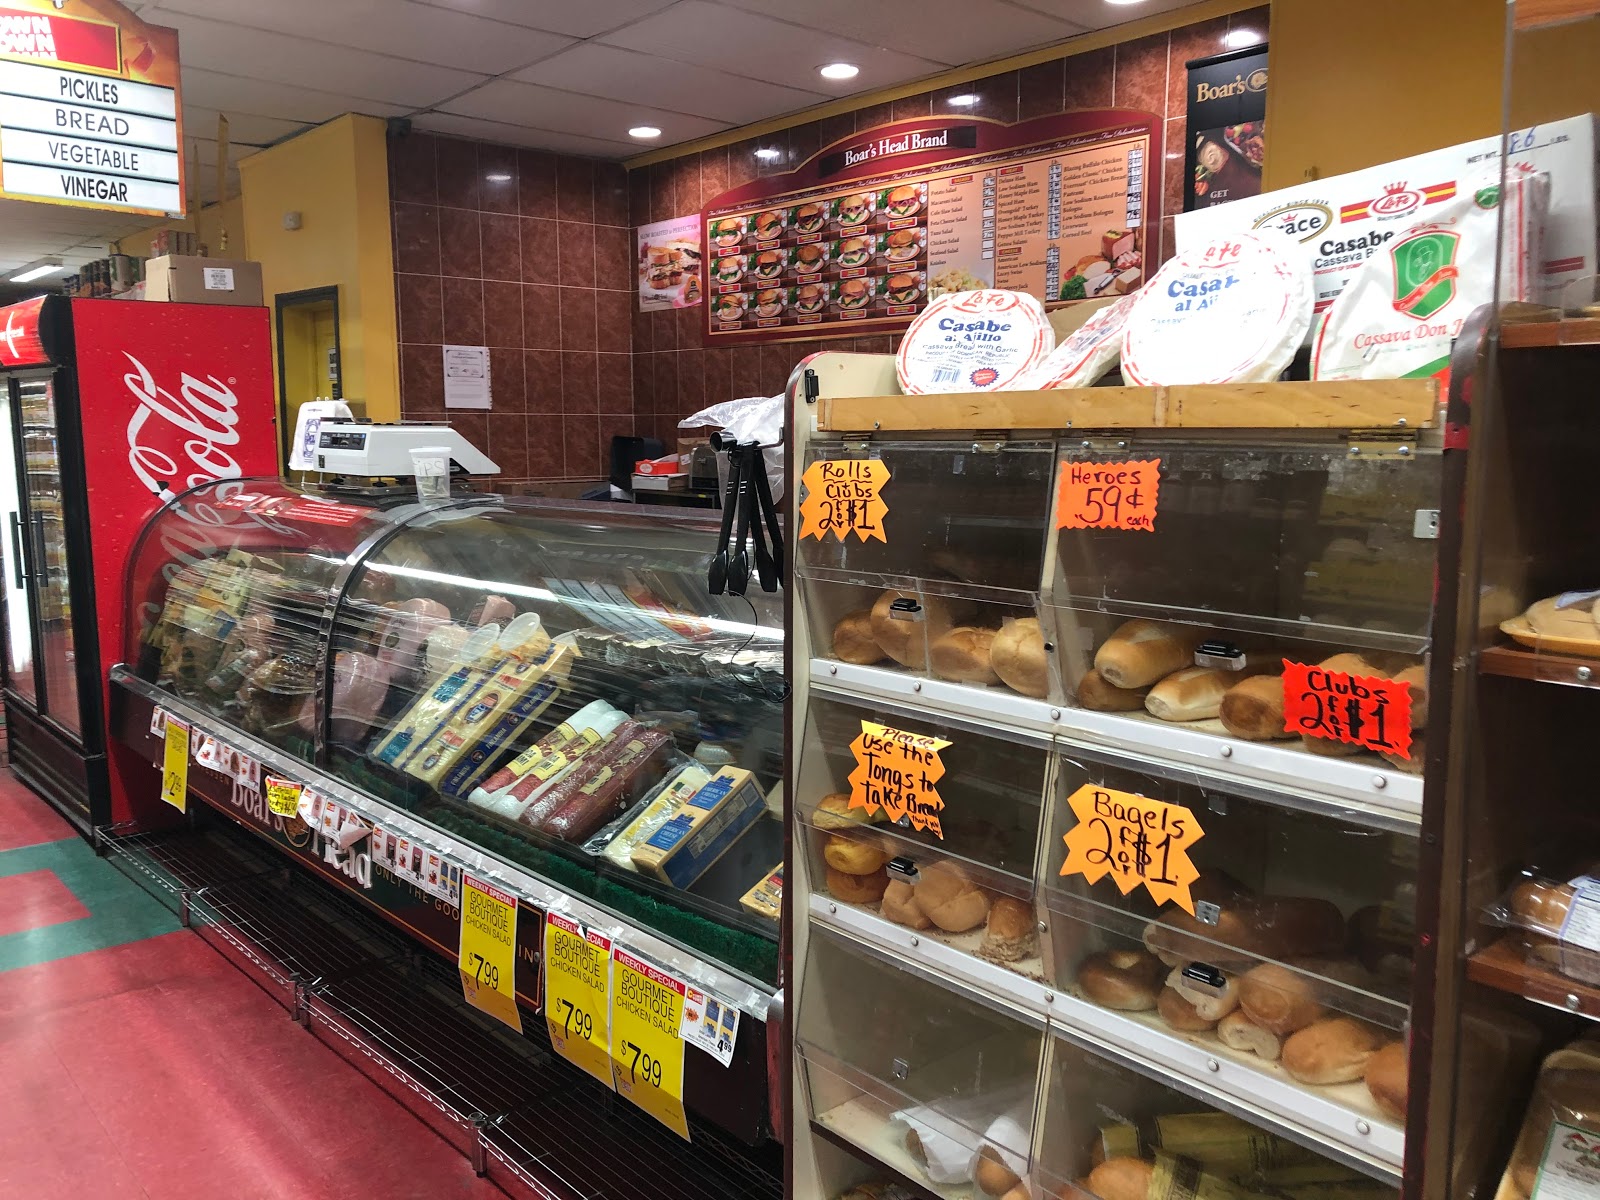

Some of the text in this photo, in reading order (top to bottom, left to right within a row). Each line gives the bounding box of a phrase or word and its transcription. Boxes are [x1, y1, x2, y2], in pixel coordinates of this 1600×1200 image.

[60, 76, 120, 104] PICKLES
[1196, 74, 1246, 103] Boar's
[55, 108, 130, 136] BREAD
[48, 141, 140, 172] VEGETABLE
[845, 130, 948, 166] Boar's Head Brand
[61, 174, 128, 202] VINEGAR
[1210, 189, 1230, 199] GET
[1320, 230, 1394, 256] Casabe
[1314, 251, 1362, 269] Cassava
[962, 291, 1006, 308] La Fe
[1175, 300, 1191, 312] al
[939, 318, 1012, 332] Casabe
[1354, 330, 1410, 350] Cassava
[1415, 324, 1448, 339] Don
[822, 461, 873, 480] Rolls
[1071, 466, 1142, 486] Heroes
[826, 483, 874, 500] Clubs
[819, 501, 836, 530] 2
[846, 499, 876, 530] $1
[1126, 514, 1150, 528] each
[1308, 671, 1390, 704] Clubs
[1300, 692, 1334, 734] 2
[899, 743, 934, 766] the
[862, 751, 934, 794] Tongs to
[1092, 791, 1185, 840] Bagels
[1086, 818, 1120, 872] 2
[467, 876, 514, 906] WEEKLY SPECIAL
[470, 891, 508, 920] GOURMET
[466, 915, 512, 946] CHICKEN SALAD
[470, 903, 508, 933] BOUTIQUE
[552, 916, 606, 948] WEEKLY ECIAL
[555, 932, 600, 964] GOURMET
[555, 944, 600, 978] BOUTIQUE
[551, 957, 604, 992] CHICKEN SALAD
[619, 953, 680, 992] WEEKLY SPECIAL
[622, 969, 675, 1007] GOURMET
[622, 982, 675, 1023] BOUTIQUE
[616, 996, 679, 1040] CHICKEN SALAD
